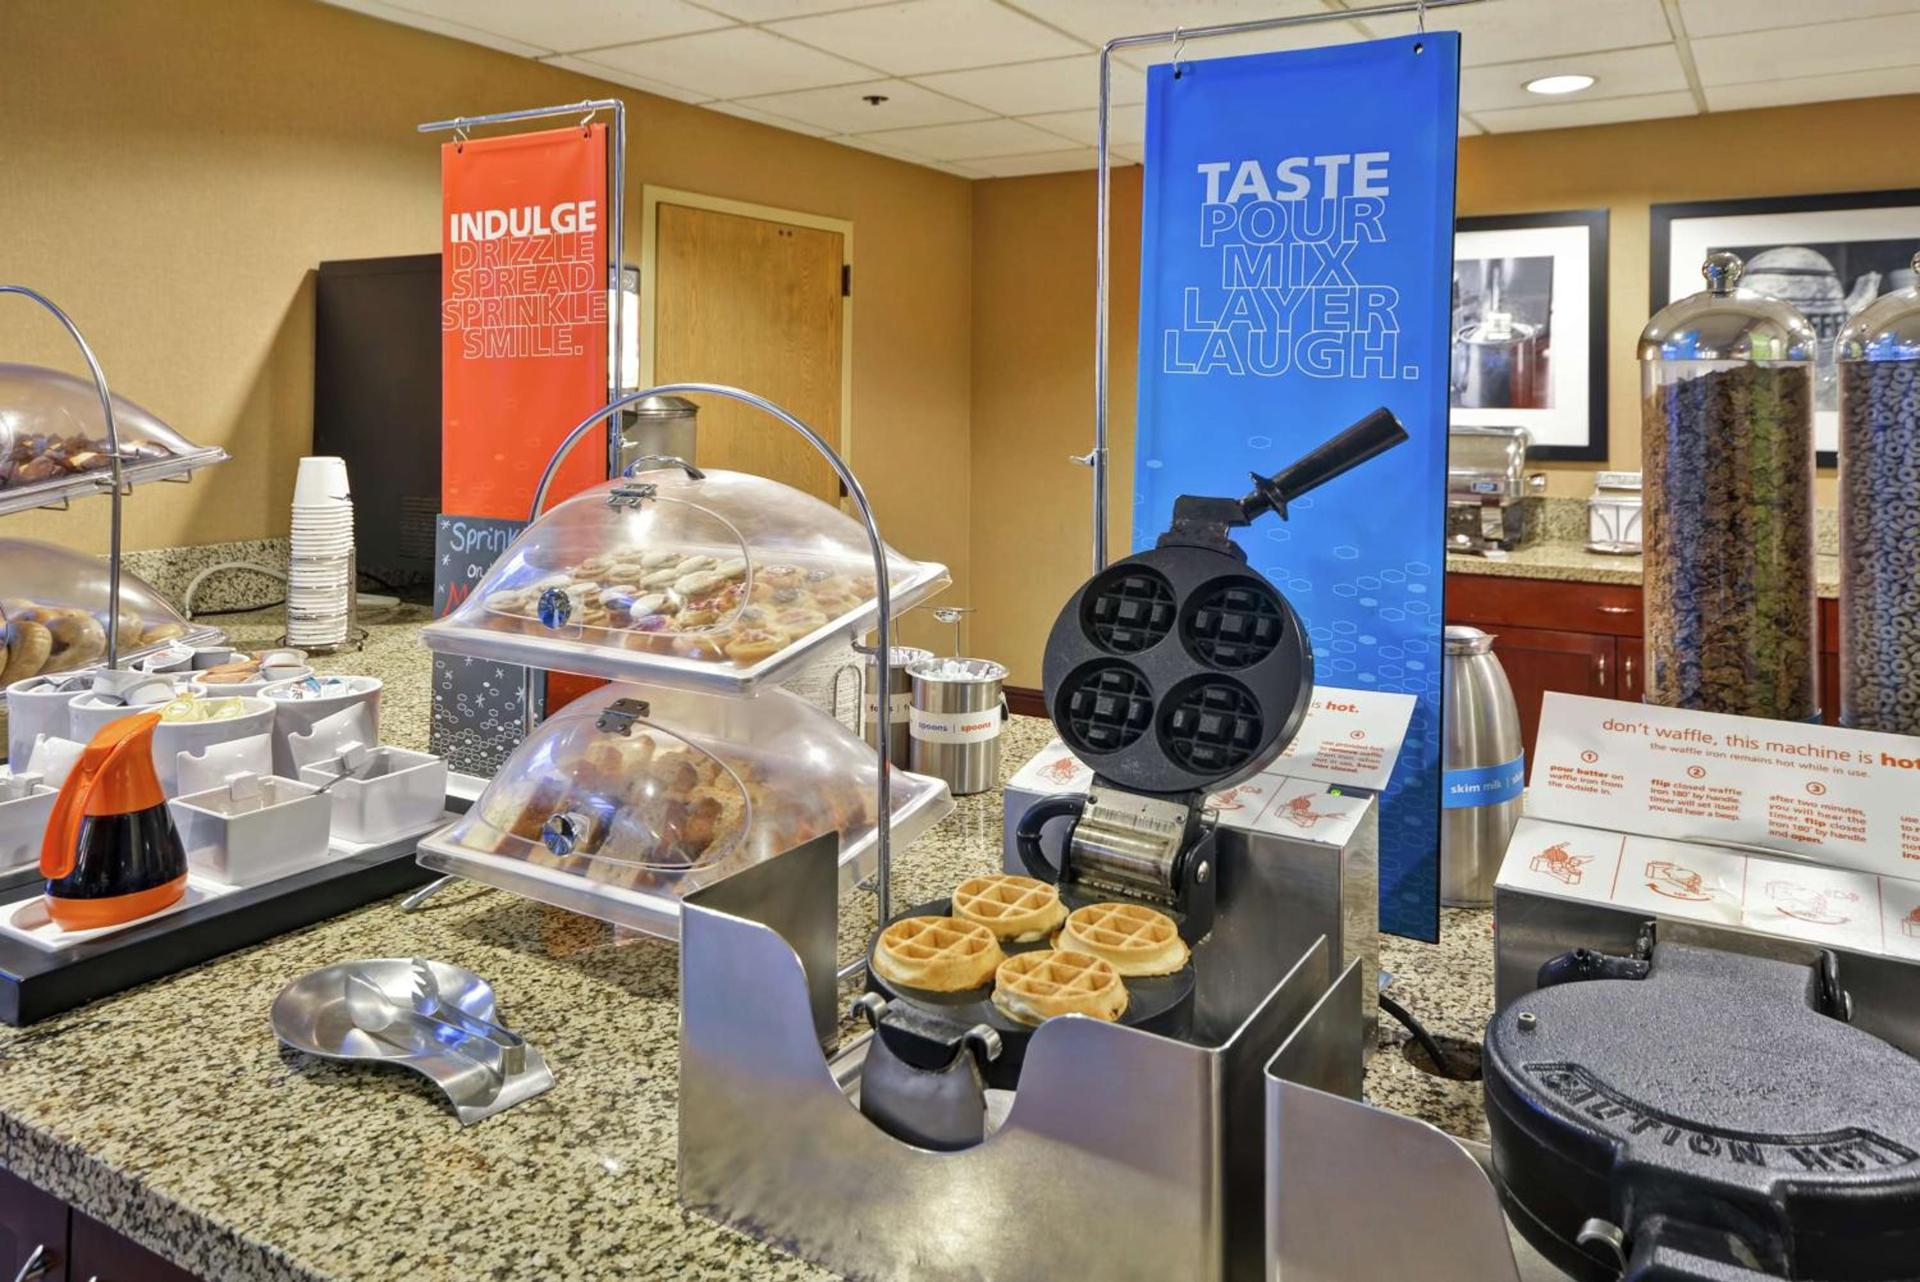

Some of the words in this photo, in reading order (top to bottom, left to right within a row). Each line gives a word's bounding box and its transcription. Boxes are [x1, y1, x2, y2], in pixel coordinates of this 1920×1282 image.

[1197, 152, 1390, 205] TASTE
[451, 200, 597, 243] INDULGE
[1200, 196, 1387, 247] POUR
[453, 231, 594, 271] DRIZZLE
[1222, 240, 1358, 289] MIX
[452, 261, 595, 300] SPREAD
[442, 290, 608, 331] SPRINKLE
[1184, 285, 1400, 333] LAYER
[464, 324, 583, 359] SMILE.
[1164, 329, 1419, 380] LAUGH.
[450, 522, 519, 554] Sprink
[1326, 700, 1359, 713] hot.
[962, 722, 992, 733] spoons
[1602, 718, 1649, 736] don't
[1655, 727, 1718, 746] waffle,
[1726, 734, 1759, 750] this
[1766, 742, 1851, 762] machine
[1858, 750, 1873, 764] is
[1650, 742, 1667, 751] the
[1670, 744, 1703, 756] waffle
[1706, 748, 1727, 759] iron
[1730, 752, 1772, 765] remains
[1776, 757, 1795, 768] hot
[1799, 762, 1829, 772] while
[1833, 766, 1844, 775] in
[1450, 784, 1480, 794] skim
[1651, 779, 1670, 788] flip
[1673, 782, 1705, 792] closed
[1769, 794, 1794, 804] after
[1797, 799, 1818, 808] two
[1769, 804, 1789, 812] you
[1768, 830, 1788, 838] and
[1804, 817, 1826, 827] flip
[1830, 822, 1866, 833] closed
[1902, 832, 1920, 842] fro
[1902, 850, 1920, 860] iro
